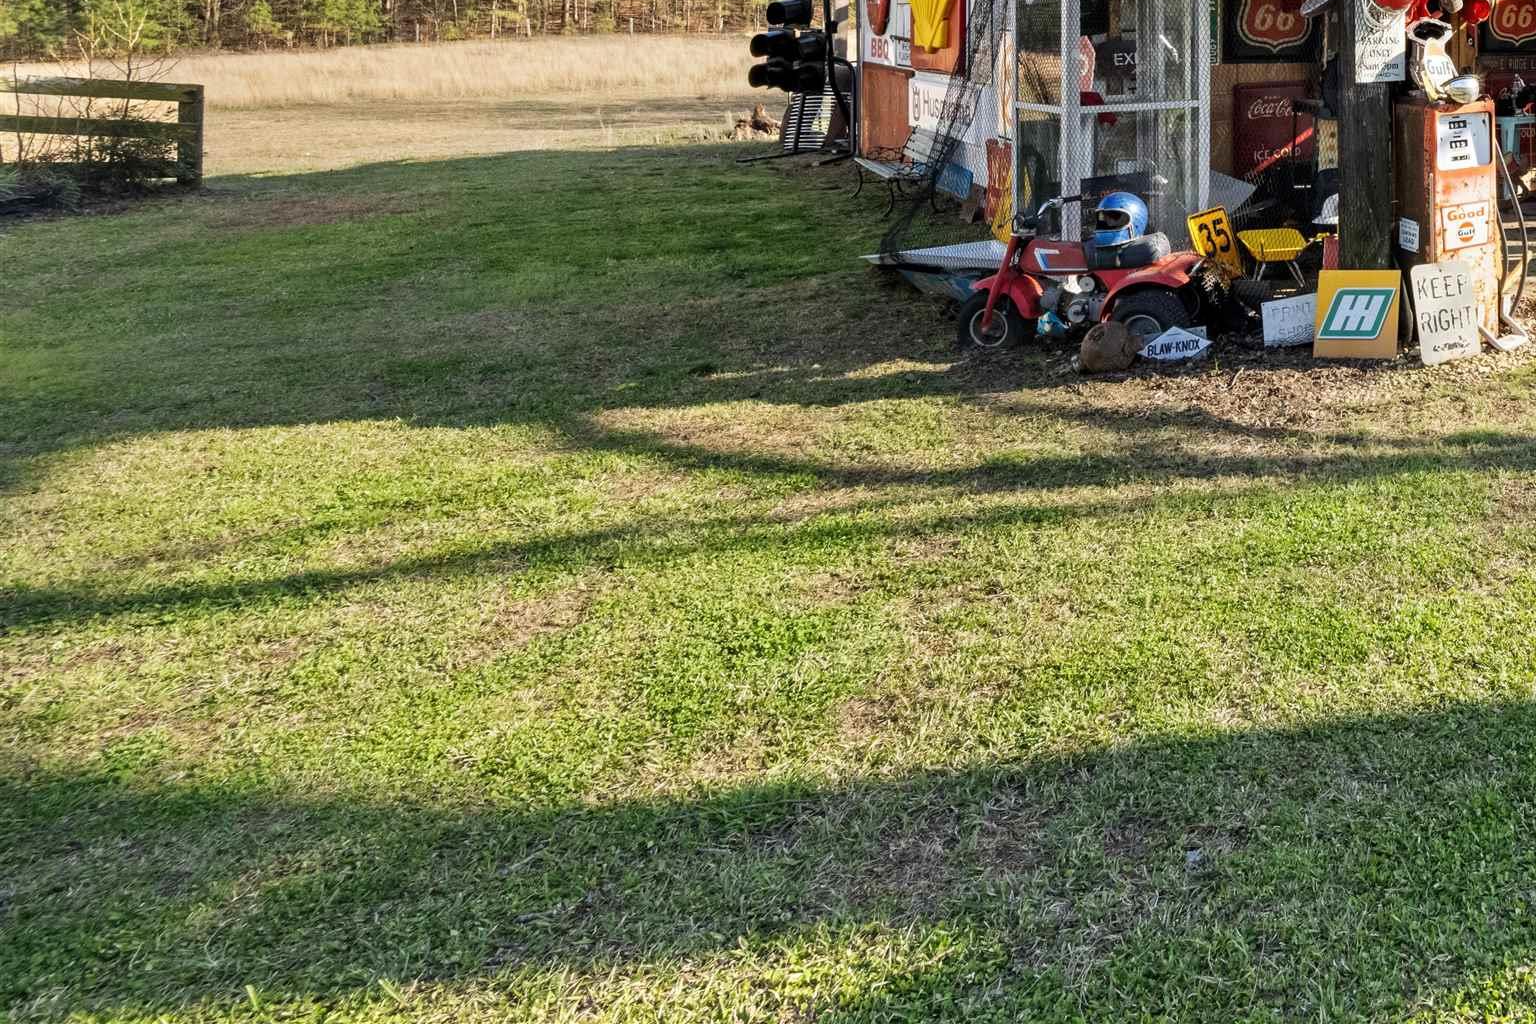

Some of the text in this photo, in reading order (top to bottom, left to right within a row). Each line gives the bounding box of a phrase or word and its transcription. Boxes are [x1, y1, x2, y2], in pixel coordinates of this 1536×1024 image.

[1502, 4, 1535, 28] 66
[871, 37, 889, 60] BBQ
[1427, 59, 1450, 75] Gulf
[1254, 149, 1269, 163] ICE
[1447, 206, 1485, 222] Good
[1198, 218, 1230, 257] 35
[1457, 228, 1476, 237] Gulf
[1417, 274, 1467, 300] KEEP
[1420, 305, 1472, 334] RIGHT
[1146, 338, 1201, 358] BLAW-KNOX
